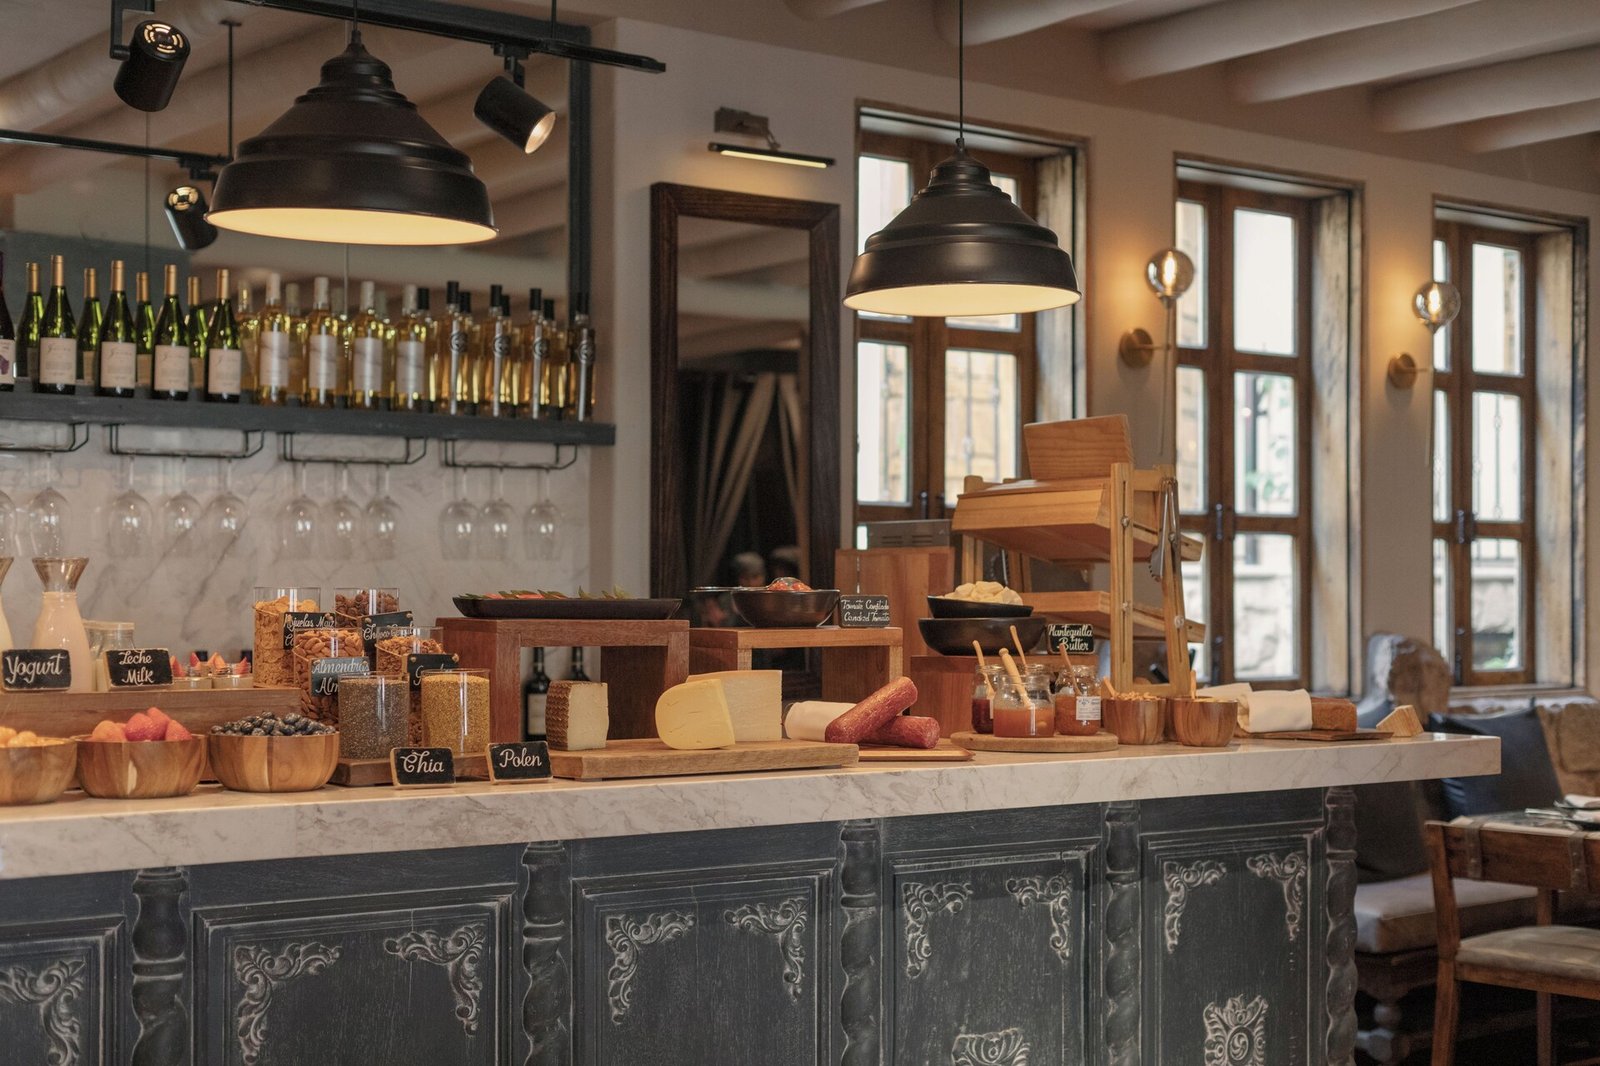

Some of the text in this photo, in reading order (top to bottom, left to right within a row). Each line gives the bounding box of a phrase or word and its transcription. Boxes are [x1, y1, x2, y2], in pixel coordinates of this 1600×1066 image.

[1056, 637, 1089, 651] Butter
[118, 650, 152, 665] Leche
[5, 653, 67, 683] Yogurt
[121, 667, 153, 686] Milk
[400, 750, 444, 773] Chia
[499, 748, 542, 768] Polen
